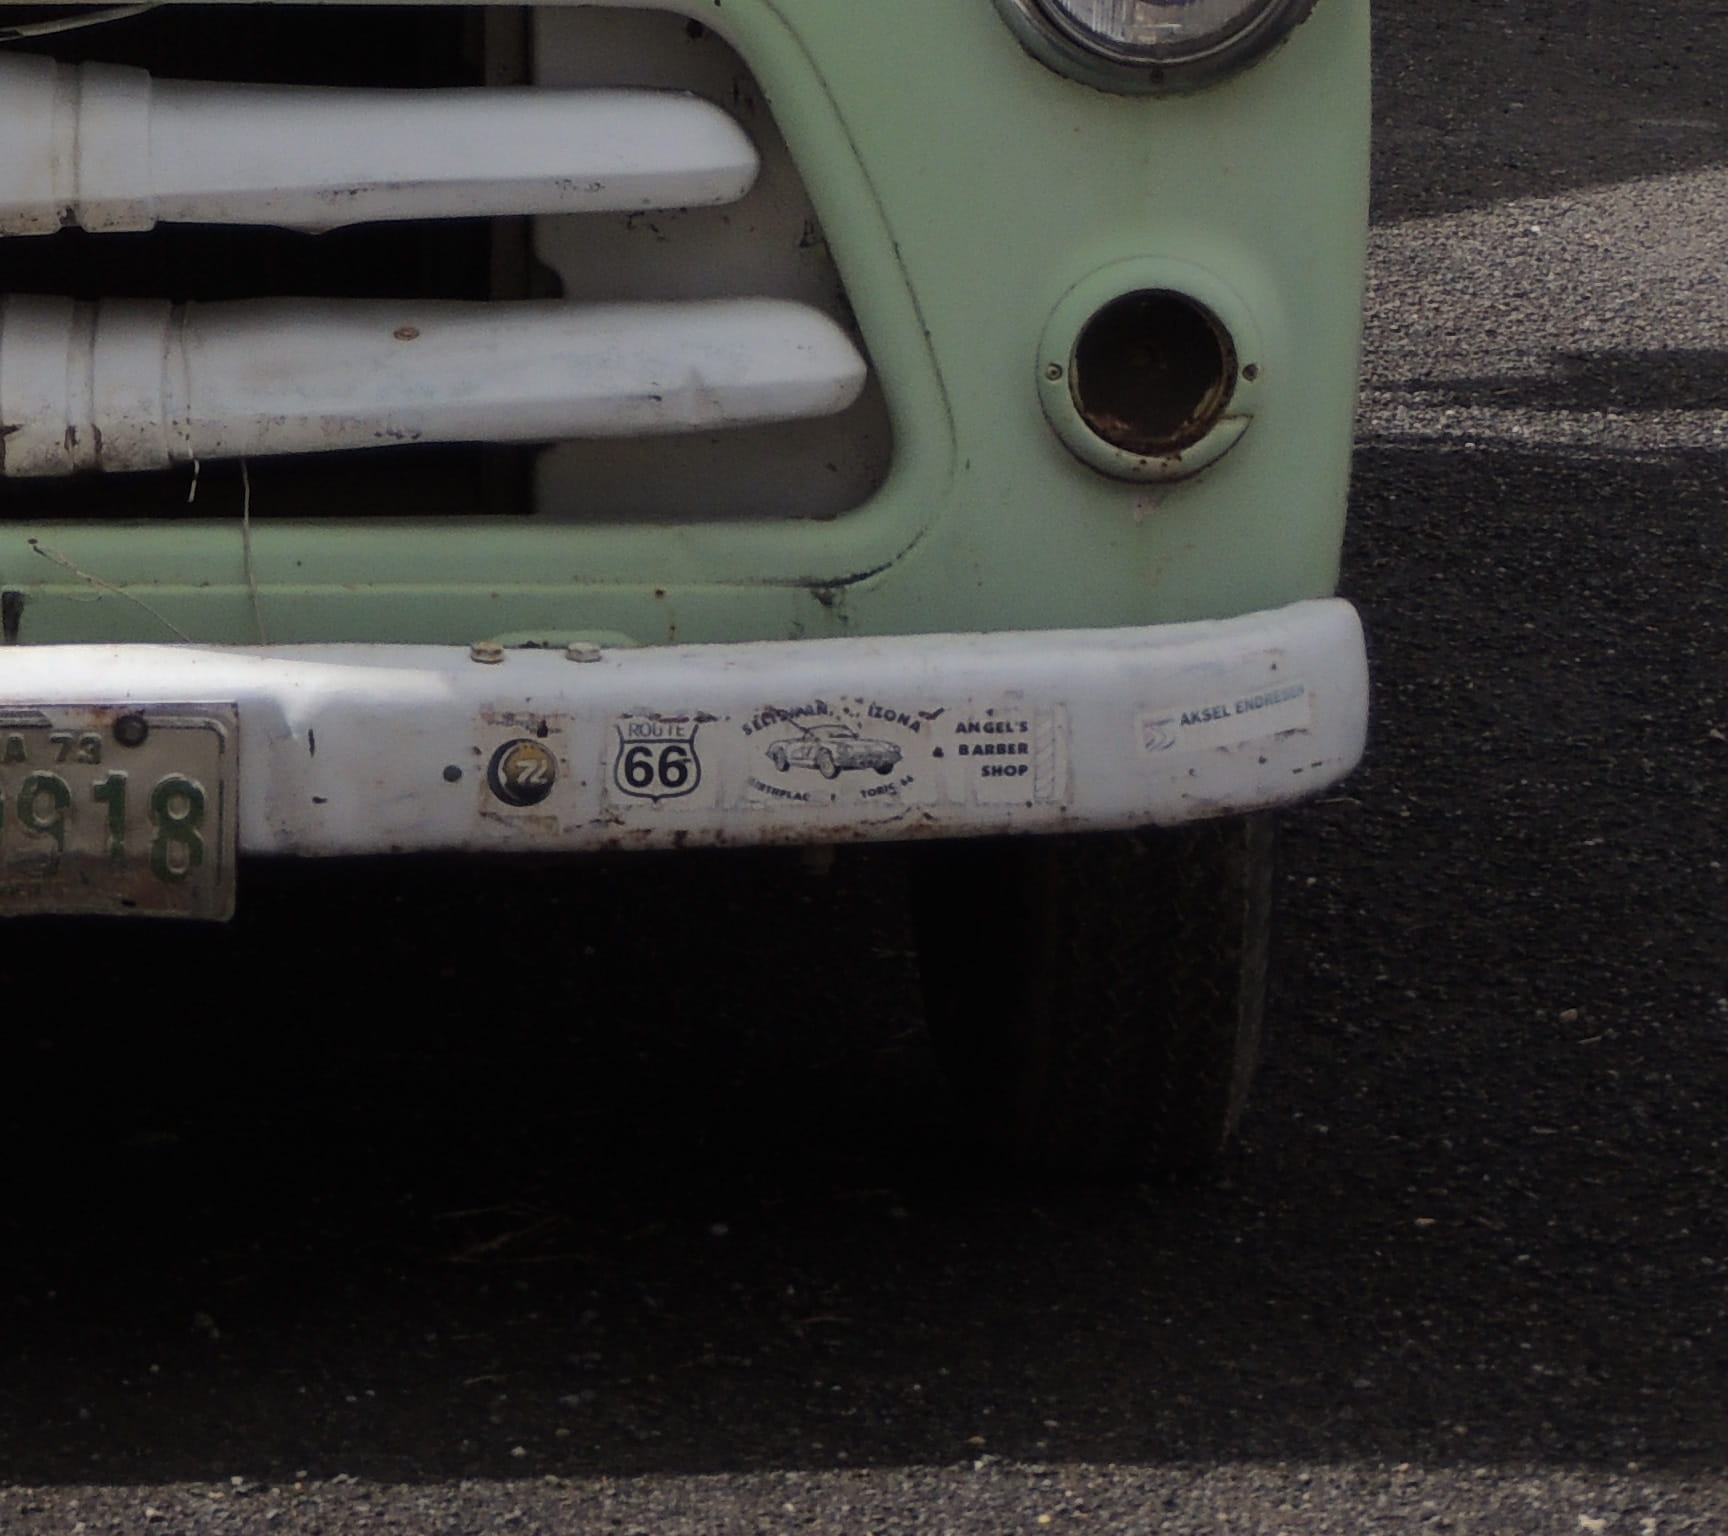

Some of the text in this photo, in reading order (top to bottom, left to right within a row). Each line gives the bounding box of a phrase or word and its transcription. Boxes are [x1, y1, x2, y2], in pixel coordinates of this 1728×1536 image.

[1180, 704, 1232, 727] AKSEL
[954, 720, 1029, 734] ANGEL'S
[50, 733, 103, 765] 73
[957, 742, 1029, 756] BARBER
[624, 745, 690, 789] 66
[980, 764, 1029, 778] SHOP
